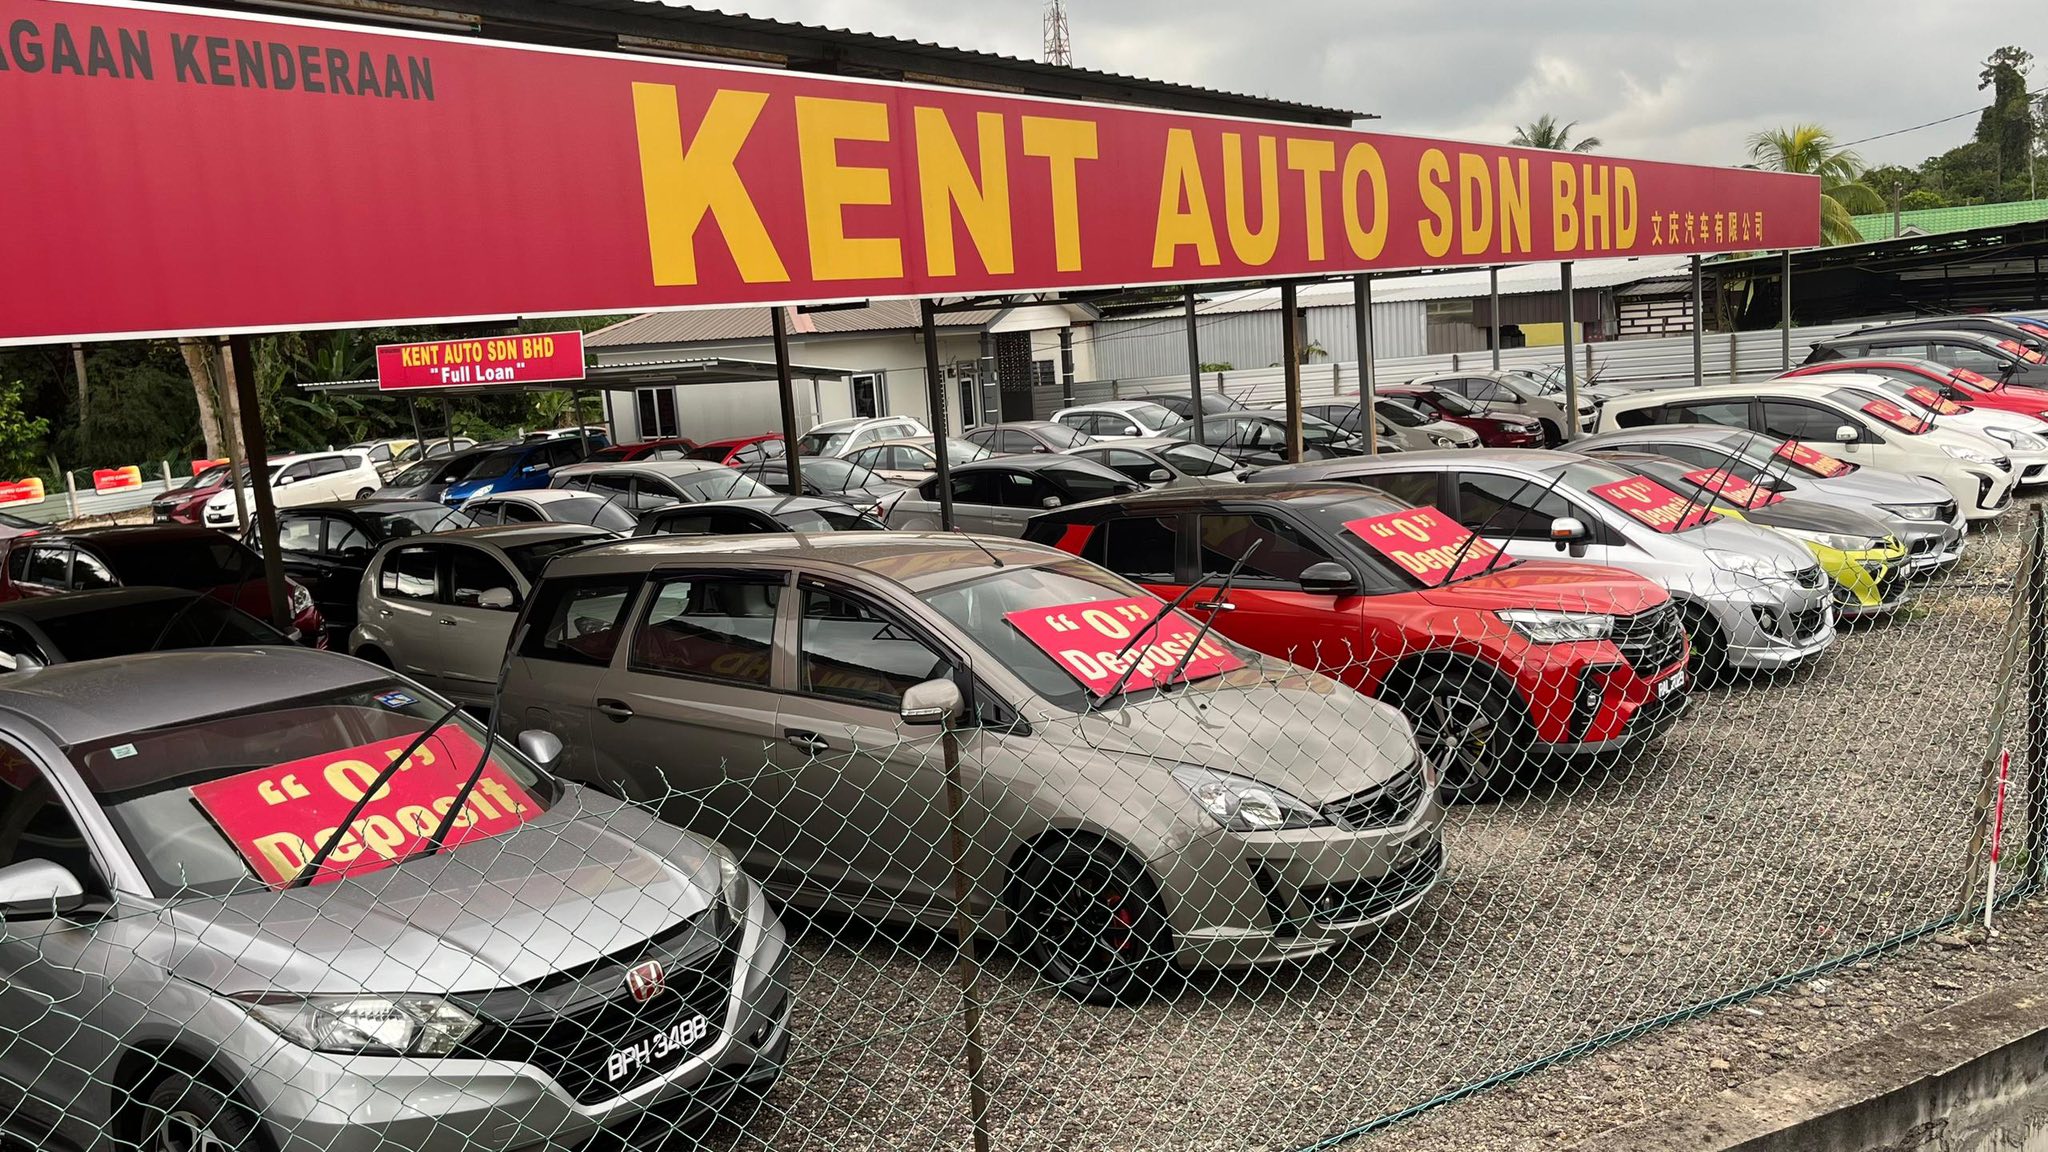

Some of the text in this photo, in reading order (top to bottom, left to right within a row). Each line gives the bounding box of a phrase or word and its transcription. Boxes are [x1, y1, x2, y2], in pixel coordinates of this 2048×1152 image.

[0, 19, 435, 101] GAAN KENDERAAN
[632, 81, 1639, 286] KENT AUTO SDN BHD
[1651, 210, 1763, 245] 文庆汽车有限公司
[402, 337, 554, 367] KENT AUTO SDN BHD
[1059, 631, 1226, 681] Deposit
[253, 777, 528, 882] Deposit
[607, 1014, 707, 1082] BPH 3488
